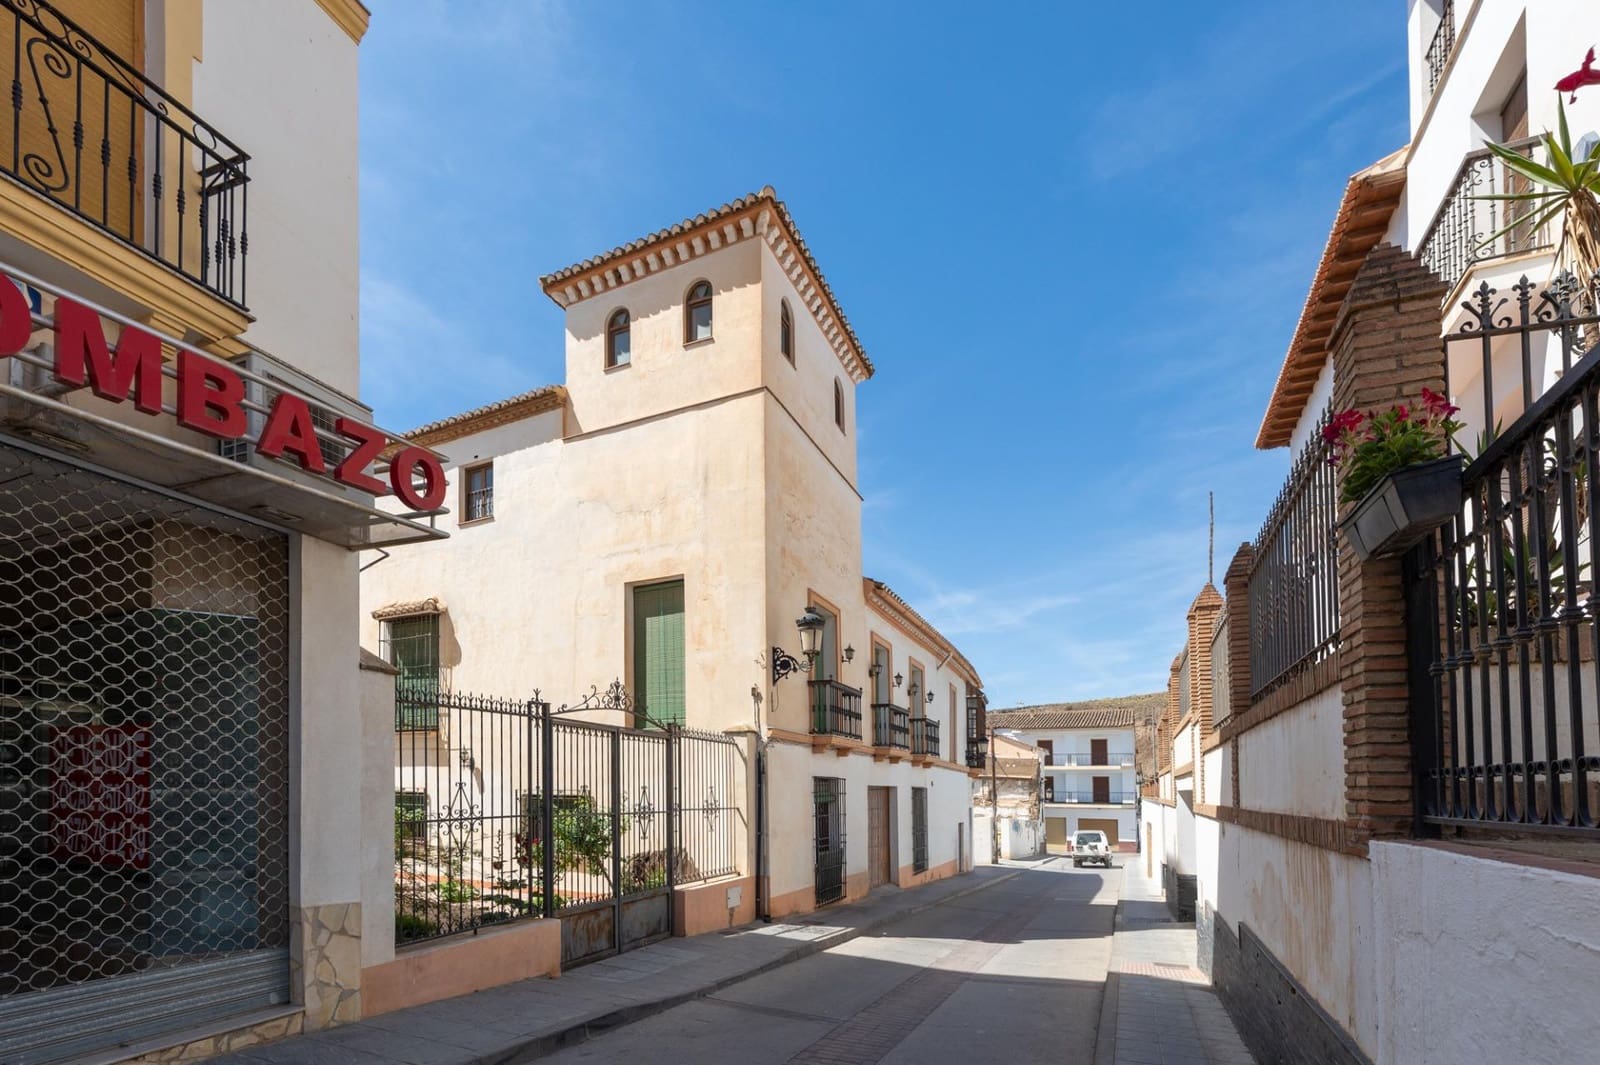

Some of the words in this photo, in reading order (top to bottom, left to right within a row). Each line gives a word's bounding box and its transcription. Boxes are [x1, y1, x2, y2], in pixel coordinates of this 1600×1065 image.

[54, 733, 74, 775] SE
[80, 732, 145, 775] VENDE
[52, 781, 95, 811] LOCAL
